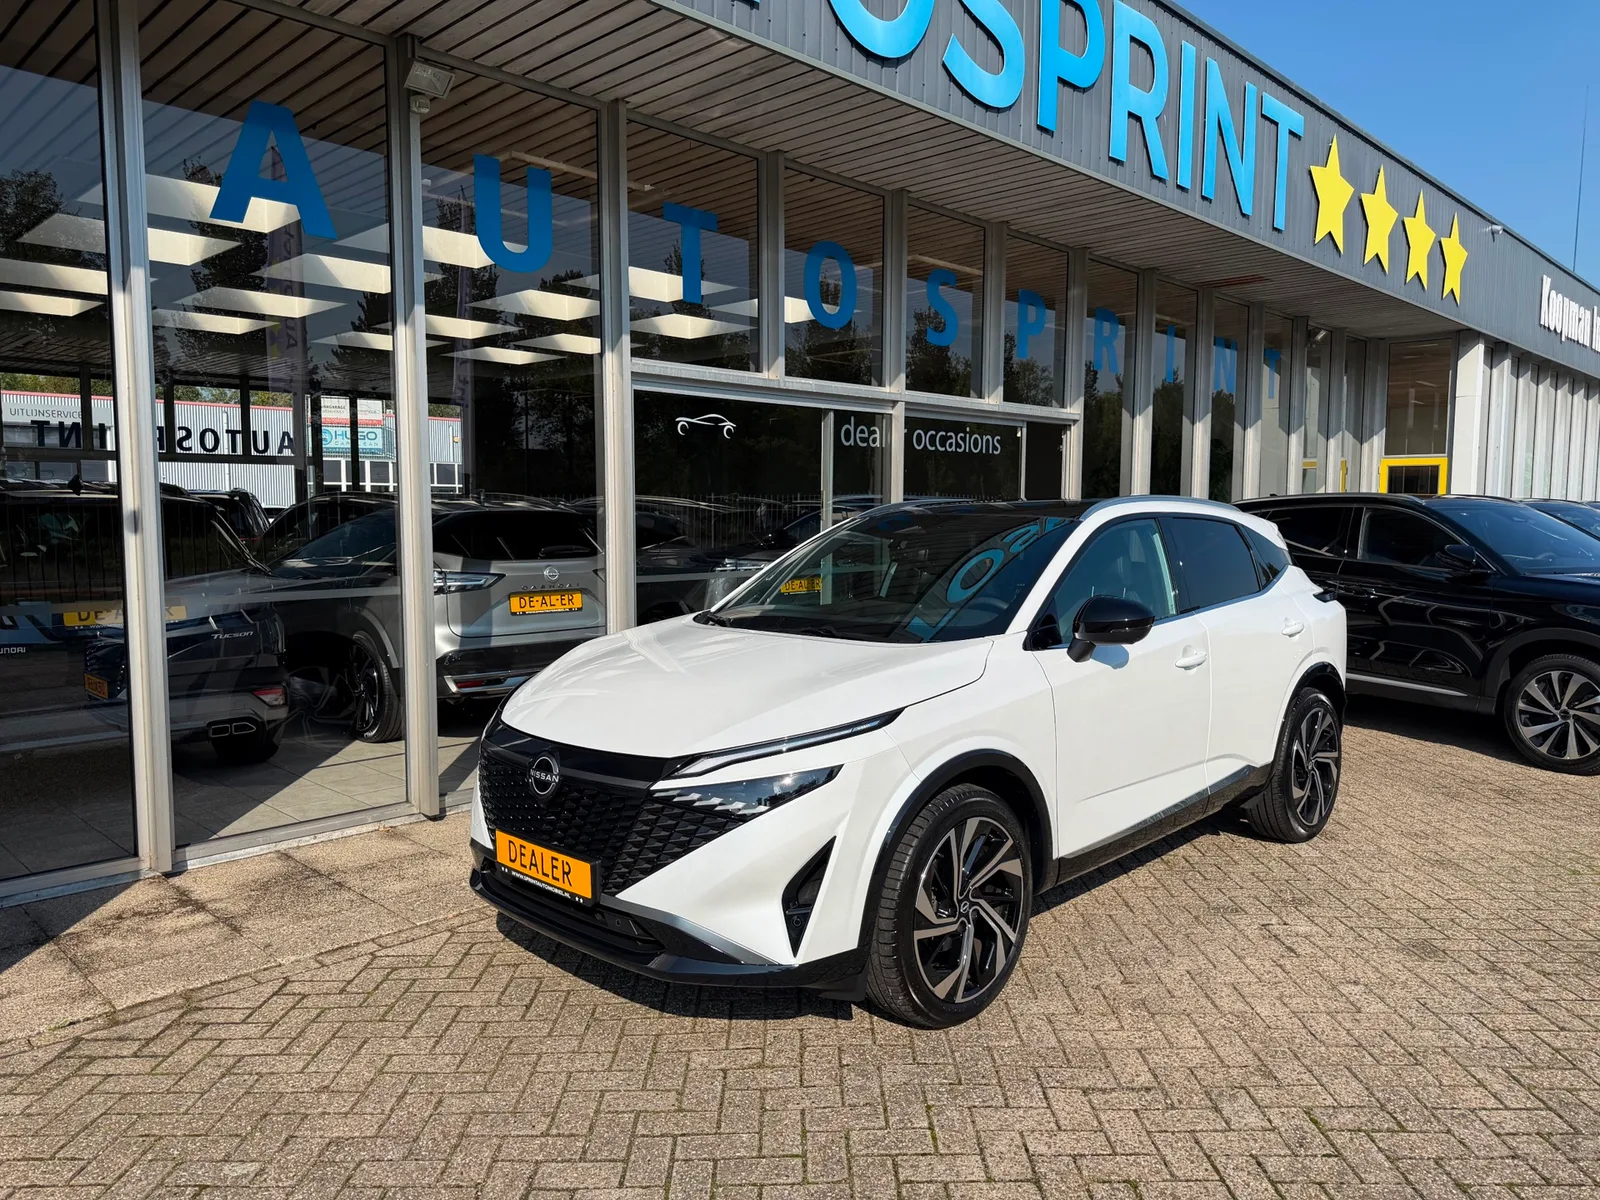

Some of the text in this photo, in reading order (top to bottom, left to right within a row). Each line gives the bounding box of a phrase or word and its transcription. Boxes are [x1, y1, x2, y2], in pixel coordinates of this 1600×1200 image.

[1540, 274, 1591, 348] Koopman
[912, 427, 1002, 455] occasions
[519, 593, 575, 609] DE-AL-ER
[530, 768, 559, 783] NISSAN
[508, 840, 572, 887] DEALER
